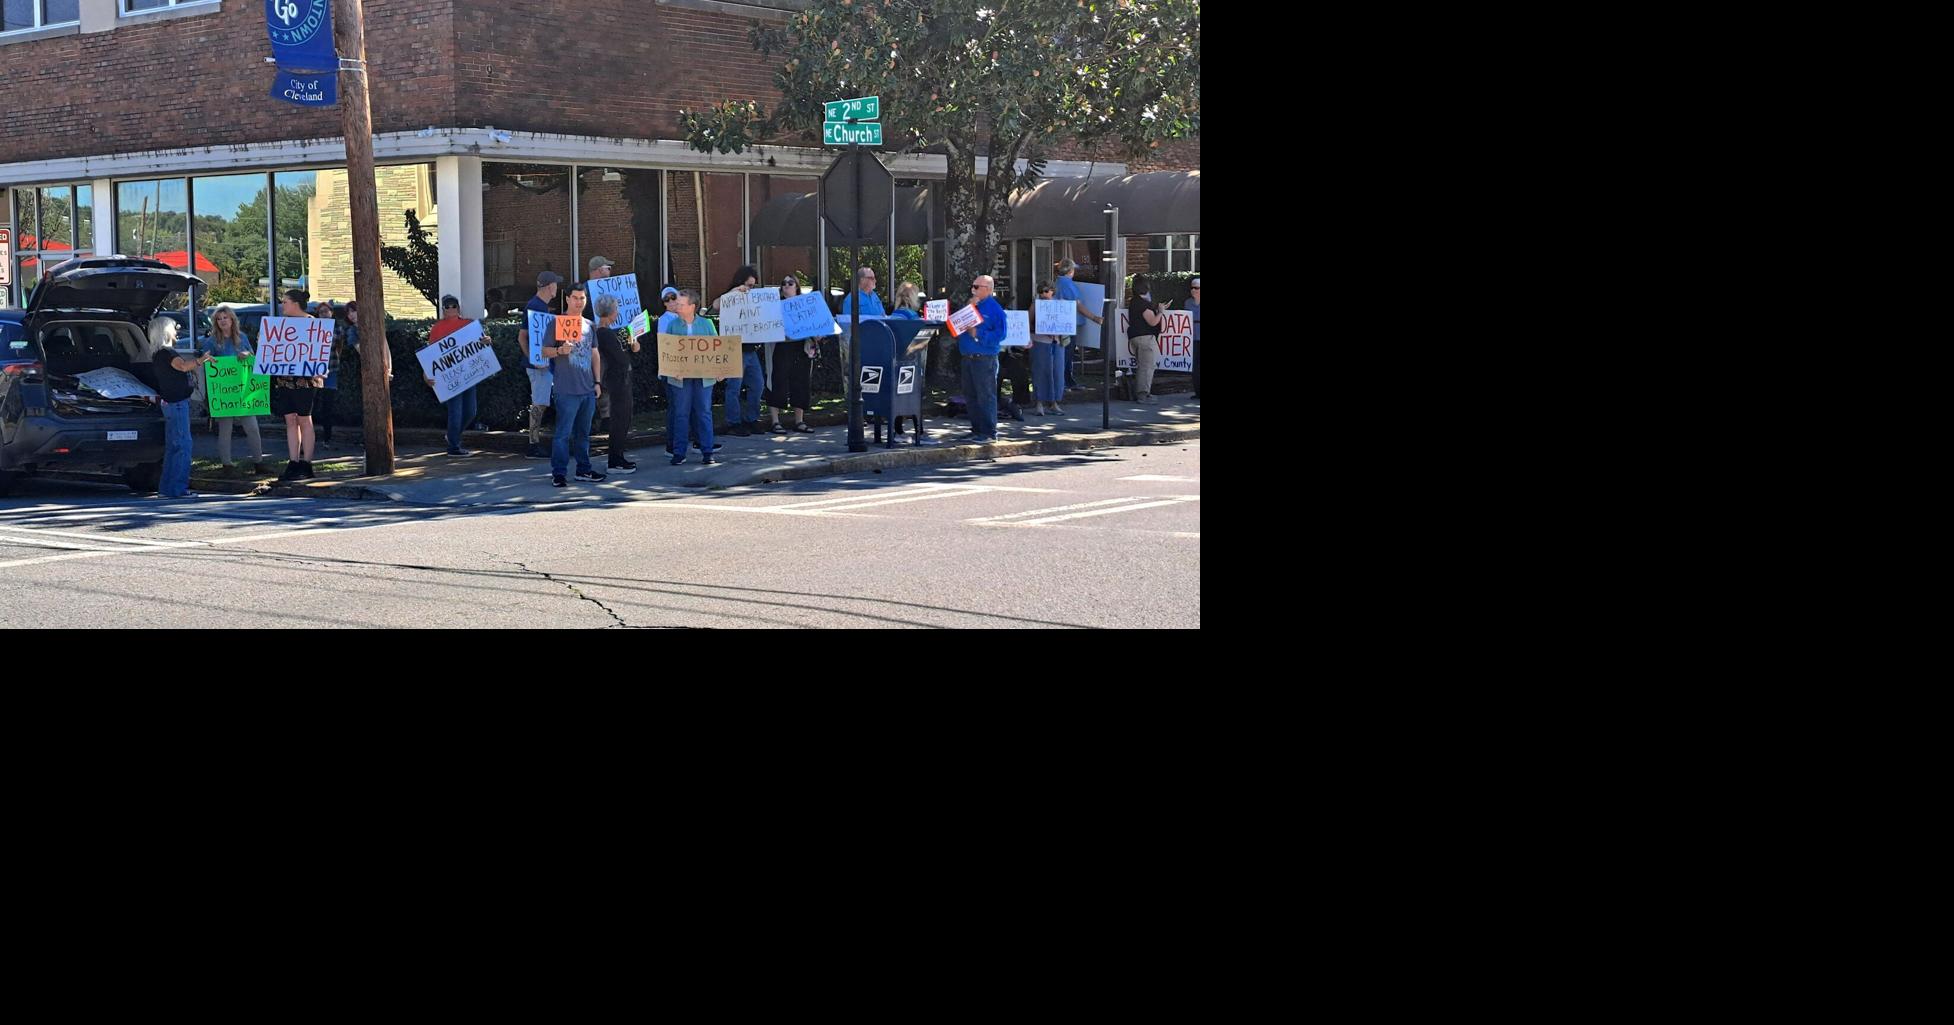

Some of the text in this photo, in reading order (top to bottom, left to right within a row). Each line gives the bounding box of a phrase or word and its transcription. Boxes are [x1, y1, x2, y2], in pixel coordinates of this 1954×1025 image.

[275, 0, 297, 26] Go
[290, 79, 319, 92] City of
[284, 89, 323, 101] Cleveland
[828, 101, 875, 121] NE 2ND ST
[825, 125, 880, 142] NE Church ST
[597, 277, 622, 295] STOP
[617, 292, 640, 307] eland
[533, 313, 555, 329] STO
[558, 318, 581, 327] VOTE
[1160, 313, 1192, 335] DATA
[263, 318, 332, 344] We the
[562, 329, 579, 338] NO
[262, 343, 331, 362] PEOPLE
[438, 337, 456, 352] NO
[678, 338, 722, 352] STOP
[1128, 335, 1191, 357] CNTER
[694, 354, 729, 364] RIVER
[1118, 358, 1127, 366] in
[1163, 358, 1192, 369] County
[209, 361, 238, 378] Save
[259, 361, 327, 376] VOTE NO
[211, 378, 269, 395] Planet Save
